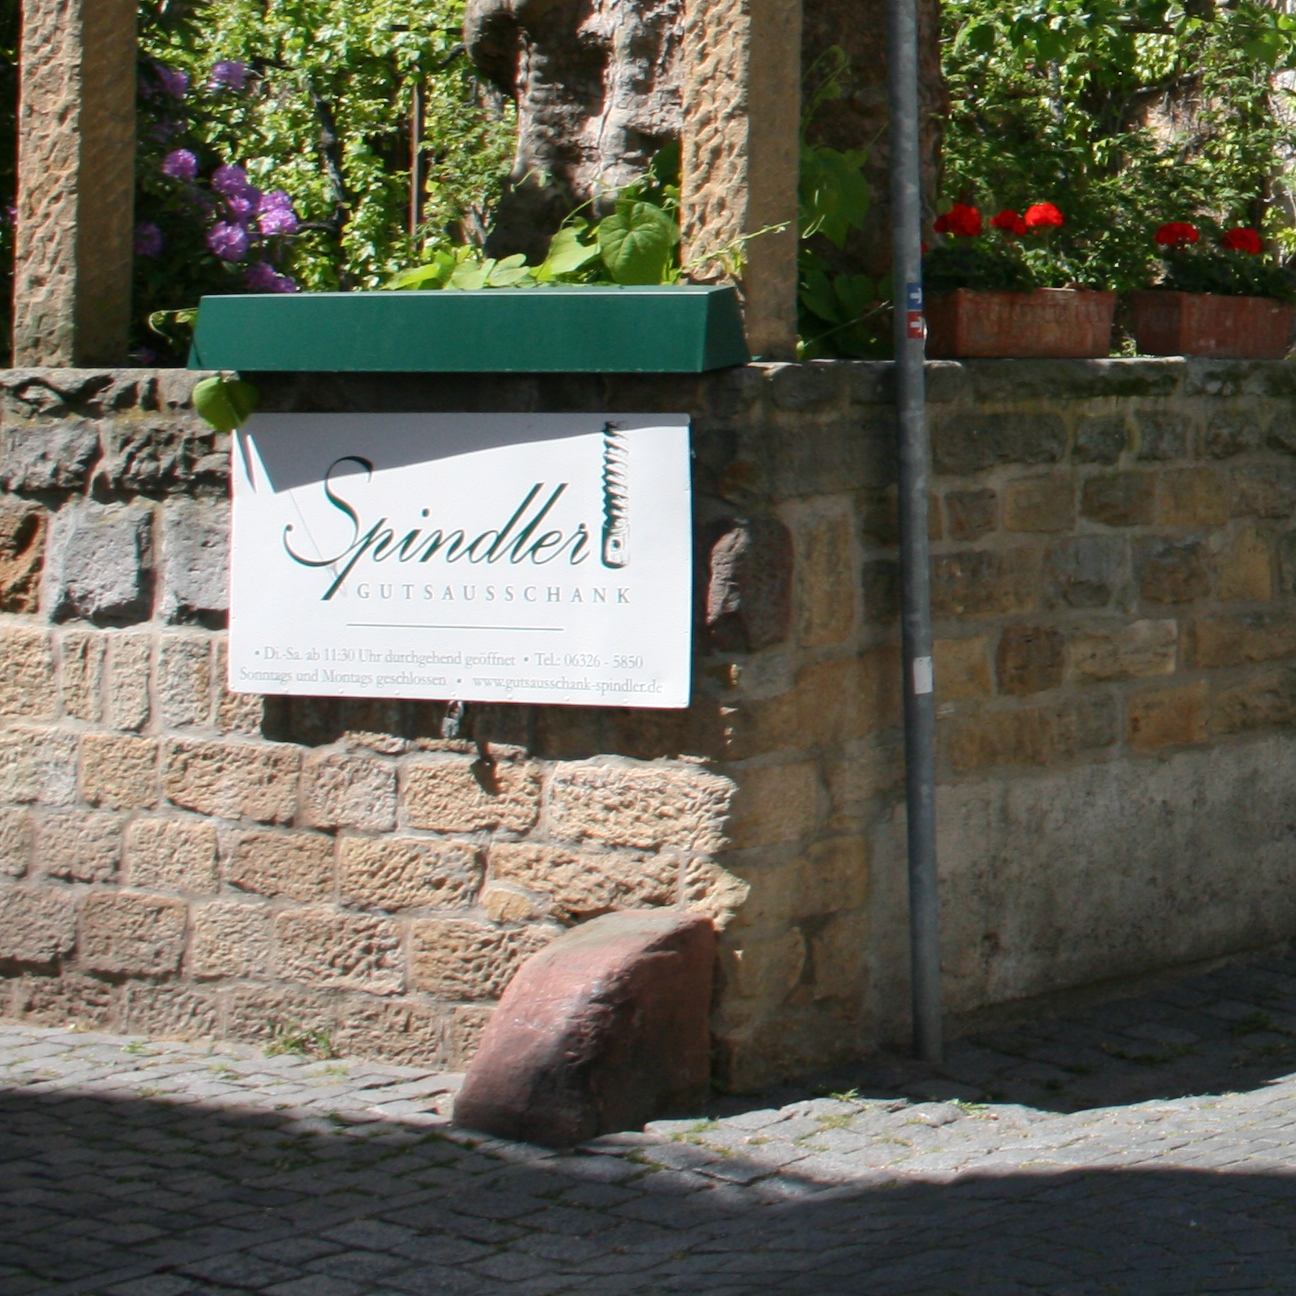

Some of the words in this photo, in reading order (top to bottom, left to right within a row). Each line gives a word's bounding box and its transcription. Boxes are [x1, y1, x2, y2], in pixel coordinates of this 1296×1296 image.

[283, 455, 592, 602] Spindler
[356, 582, 632, 605] GUTSAUSSCHANK
[305, 647, 321, 661] ab
[323, 648, 356, 662] 11:30
[358, 648, 381, 664] Uhr
[384, 650, 462, 668] durchgehend
[465, 652, 516, 671] geöffnet
[563, 653, 601, 668] 06326
[612, 654, 644, 670] 5850
[239, 665, 293, 686] Sonntags
[296, 668, 319, 683] und
[321, 669, 373, 687] Montags
[376, 671, 447, 688] geschlossen
[472, 673, 663, 696] www.gutsausschank-spindler.de
